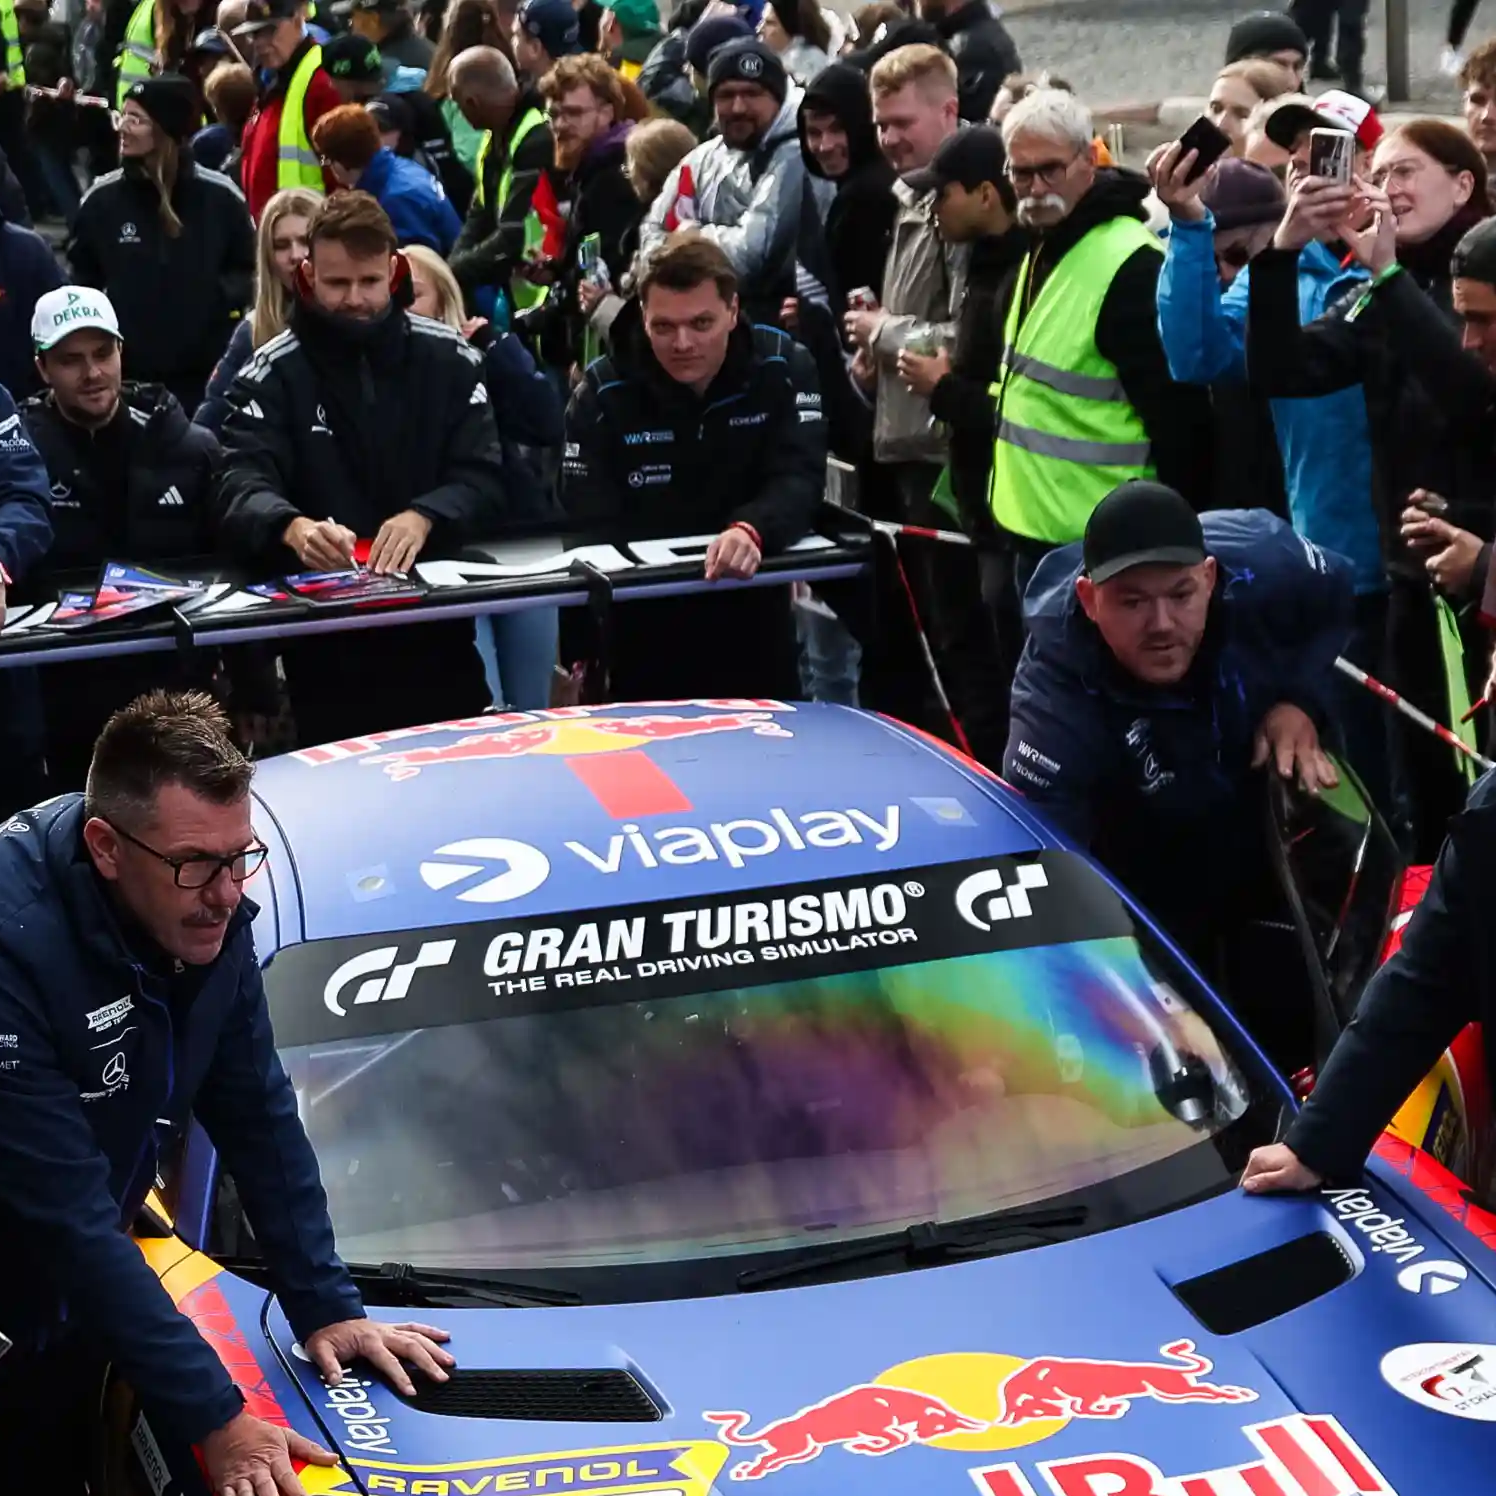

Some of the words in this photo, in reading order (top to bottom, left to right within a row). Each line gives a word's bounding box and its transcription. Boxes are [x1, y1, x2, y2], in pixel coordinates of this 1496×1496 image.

[54, 306, 104, 327] DEKRA
[565, 804, 902, 875] viaplay
[483, 916, 646, 977] GRAN
[488, 976, 546, 996] THE
[555, 965, 631, 988] REAL
[637, 949, 755, 979] DRIVING
[760, 926, 919, 962] SIMULATOR
[1320, 1186, 1426, 1264] viaplay
